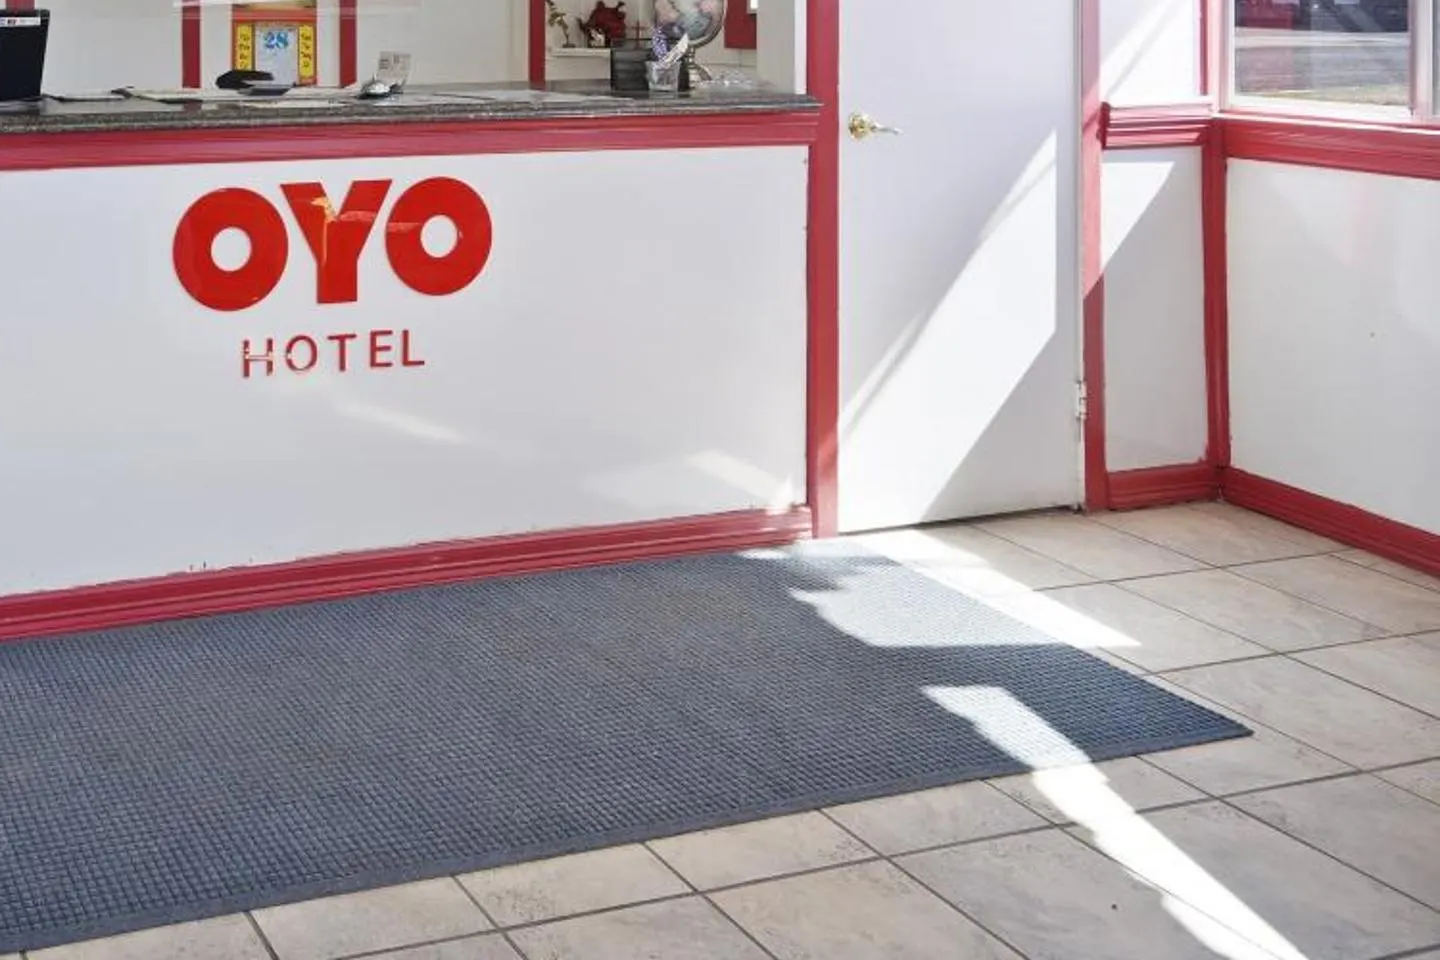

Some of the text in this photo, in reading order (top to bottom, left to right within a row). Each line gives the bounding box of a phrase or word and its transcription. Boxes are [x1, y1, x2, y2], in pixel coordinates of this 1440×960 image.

[263, 31, 289, 49] 28
[172, 176, 493, 312] OYO
[241, 329, 426, 379] HOTEL
